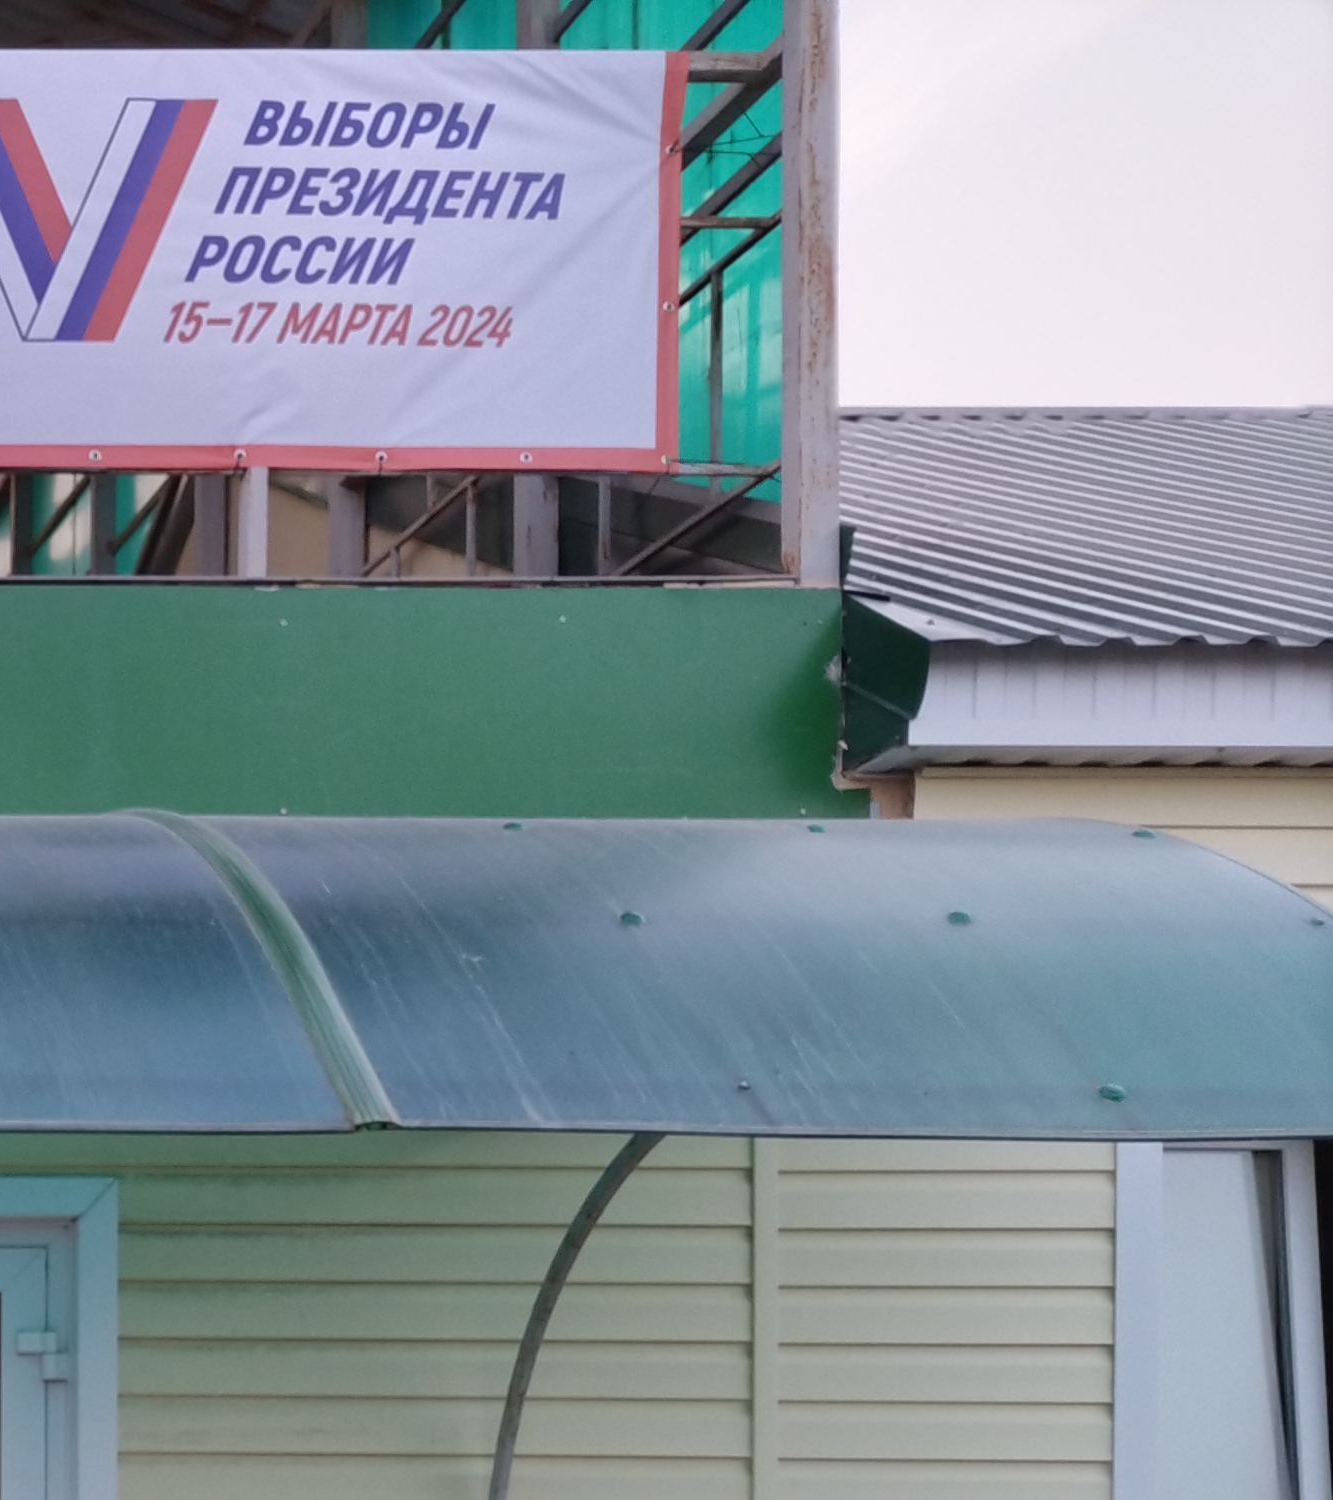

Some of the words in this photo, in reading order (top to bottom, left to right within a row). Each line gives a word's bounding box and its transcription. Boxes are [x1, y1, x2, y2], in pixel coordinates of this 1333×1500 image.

[243, 100, 496, 150] ВЫБОРЫ
[213, 166, 566, 225] ПРЕЗИДЕНТА
[184, 234, 415, 285] РОССИИ
[276, 303, 414, 346] МАРТА
[417, 306, 513, 348] 2024
